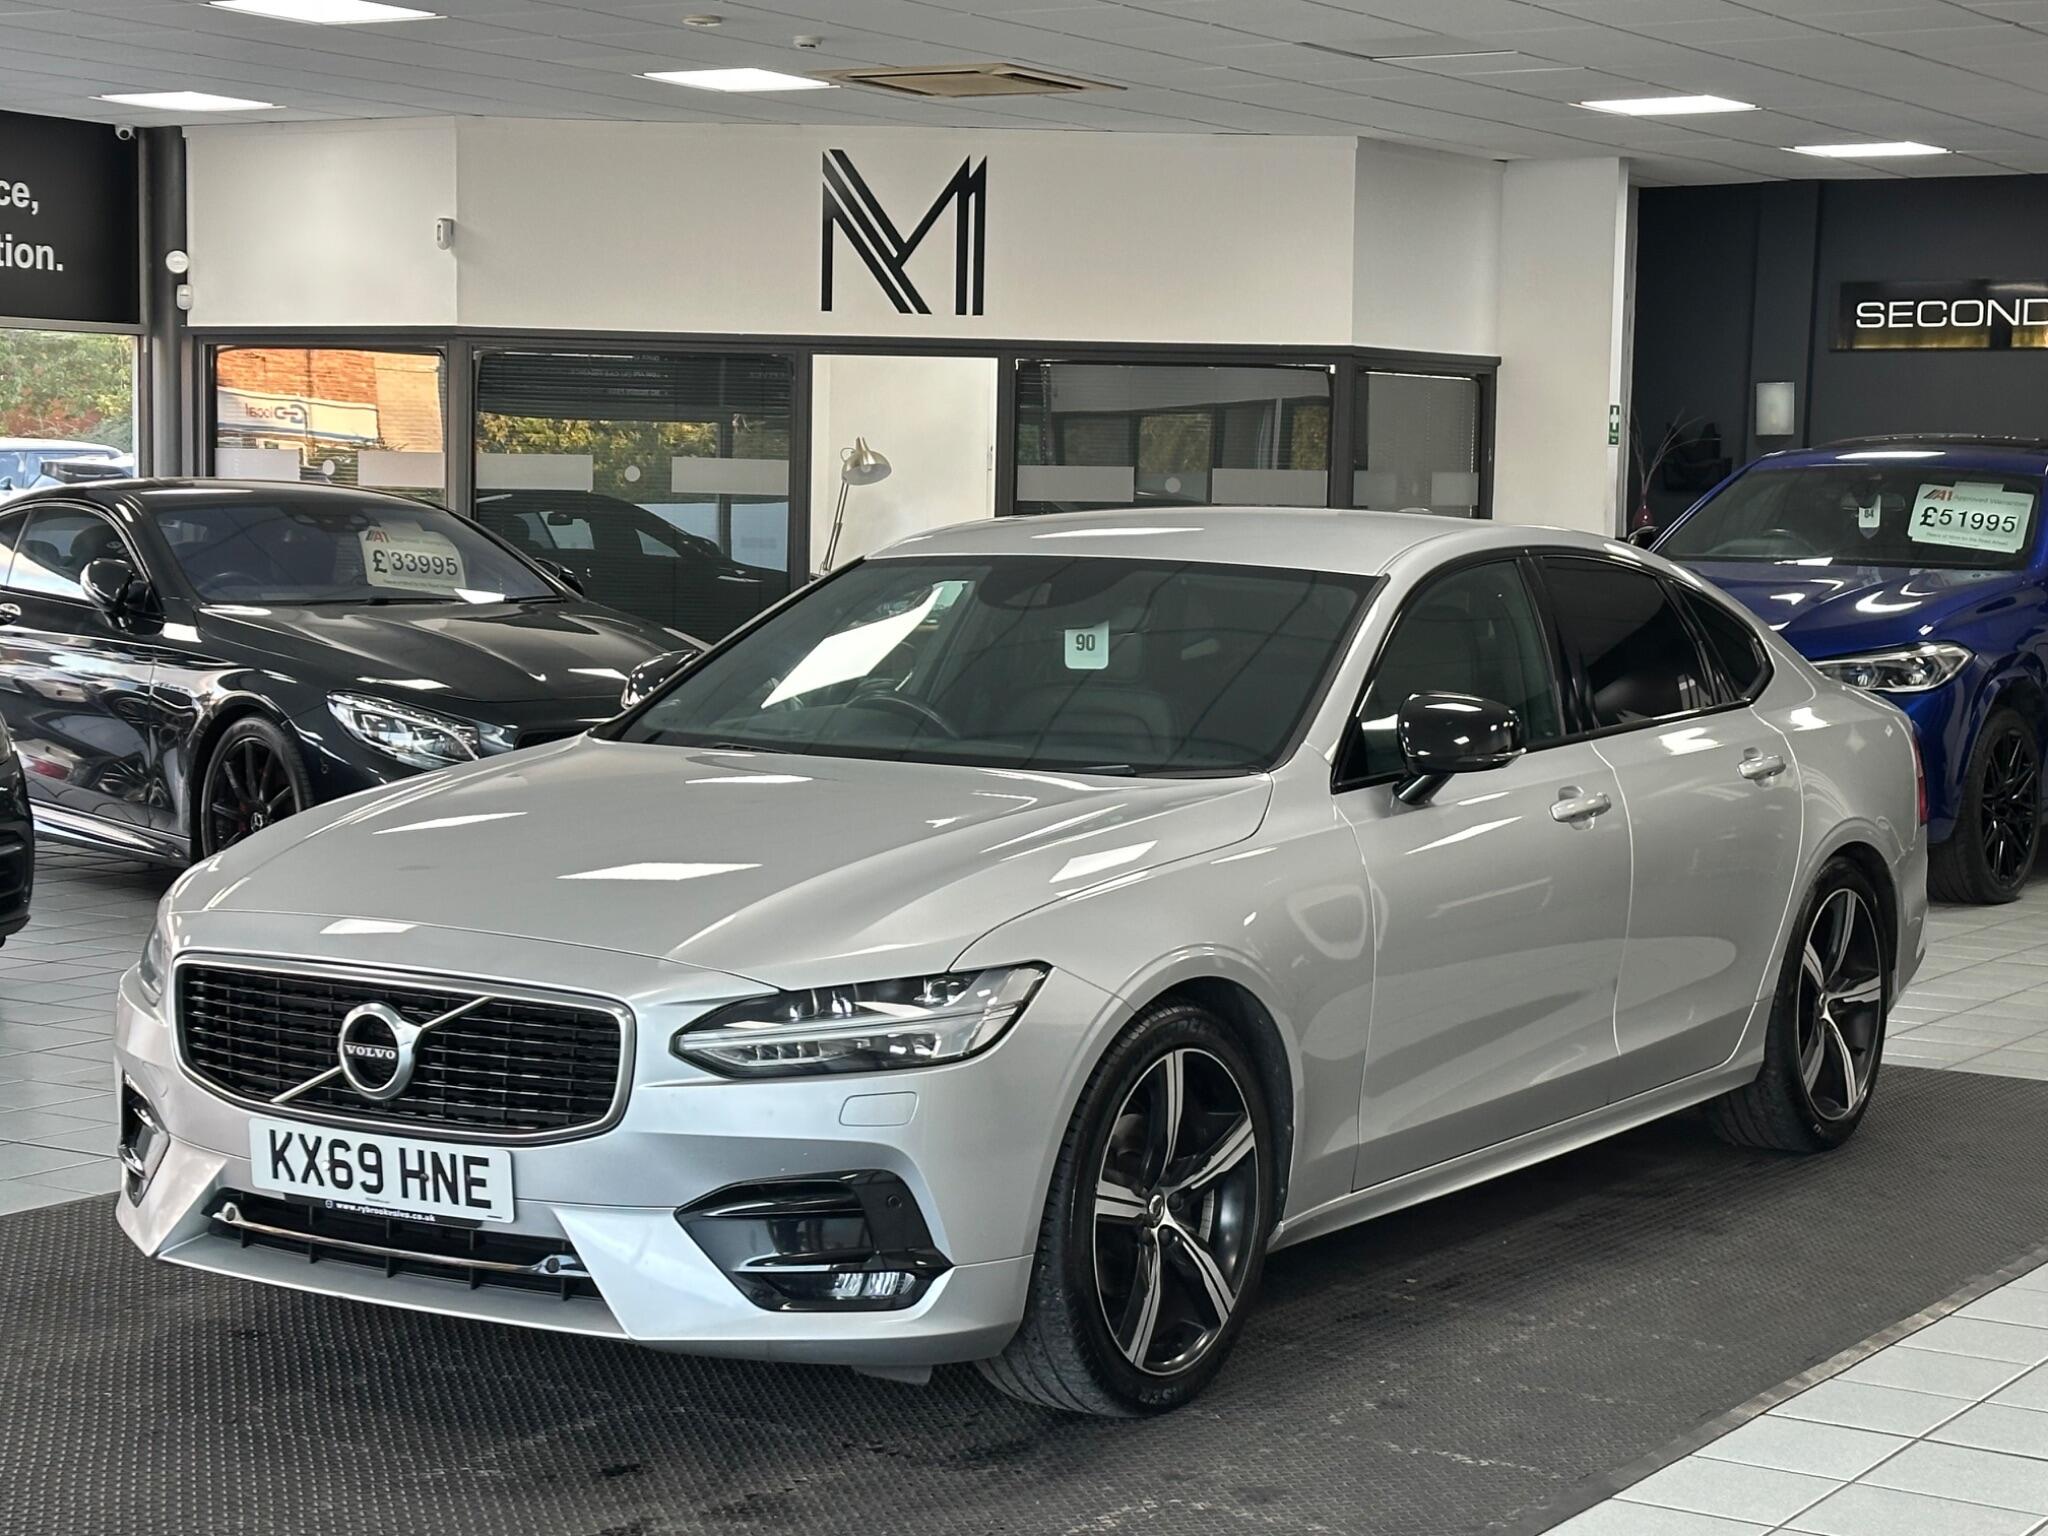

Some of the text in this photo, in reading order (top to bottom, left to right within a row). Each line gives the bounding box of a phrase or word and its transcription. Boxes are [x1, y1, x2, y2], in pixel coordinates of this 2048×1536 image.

[1856, 298, 2048, 328] SECOND
[1920, 506, 2017, 533] £51995
[372, 550, 458, 576] £33995
[1076, 633, 1096, 651] 90
[344, 1044, 396, 1060] VOLVO
[269, 1129, 493, 1210] KX69 HNE
